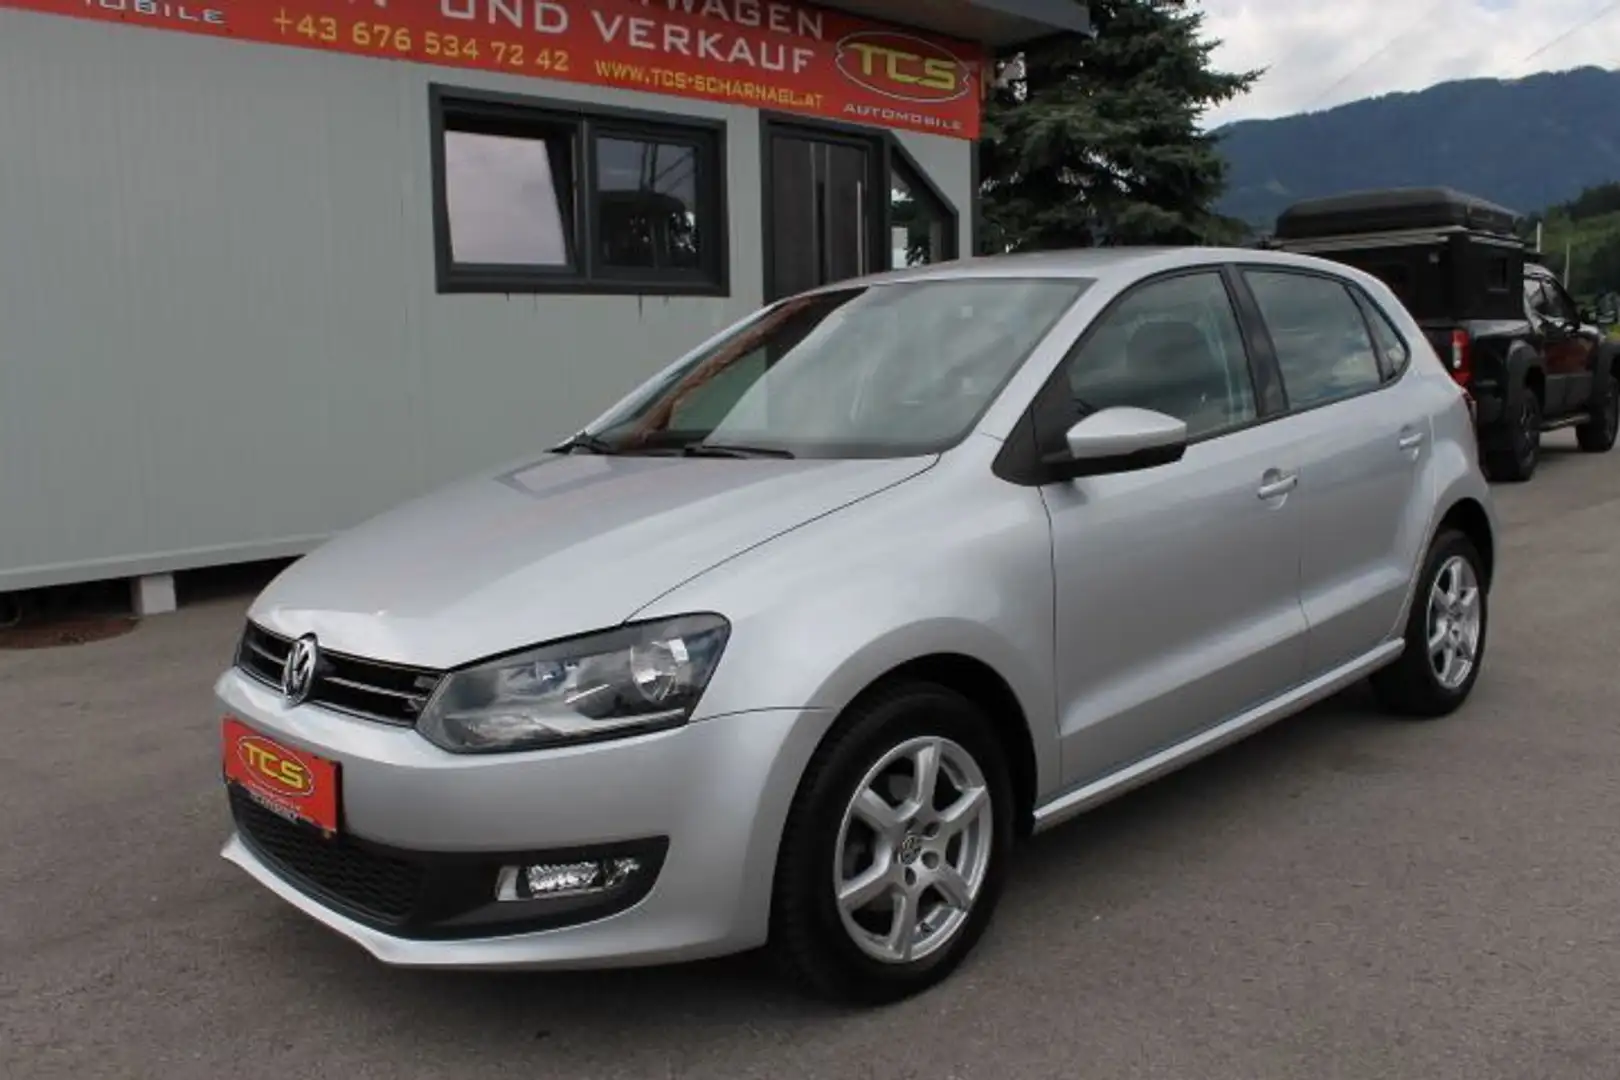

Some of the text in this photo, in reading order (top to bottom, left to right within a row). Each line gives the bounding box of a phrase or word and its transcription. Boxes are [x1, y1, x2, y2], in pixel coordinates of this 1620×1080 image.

[273, 7, 569, 71] +43 676 534 72 42
[441, 0, 815, 73] UND VERKAUF
[846, 42, 956, 90] TCS
[843, 103, 963, 130] AUTOMOBILE
[243, 741, 303, 788] TCS
